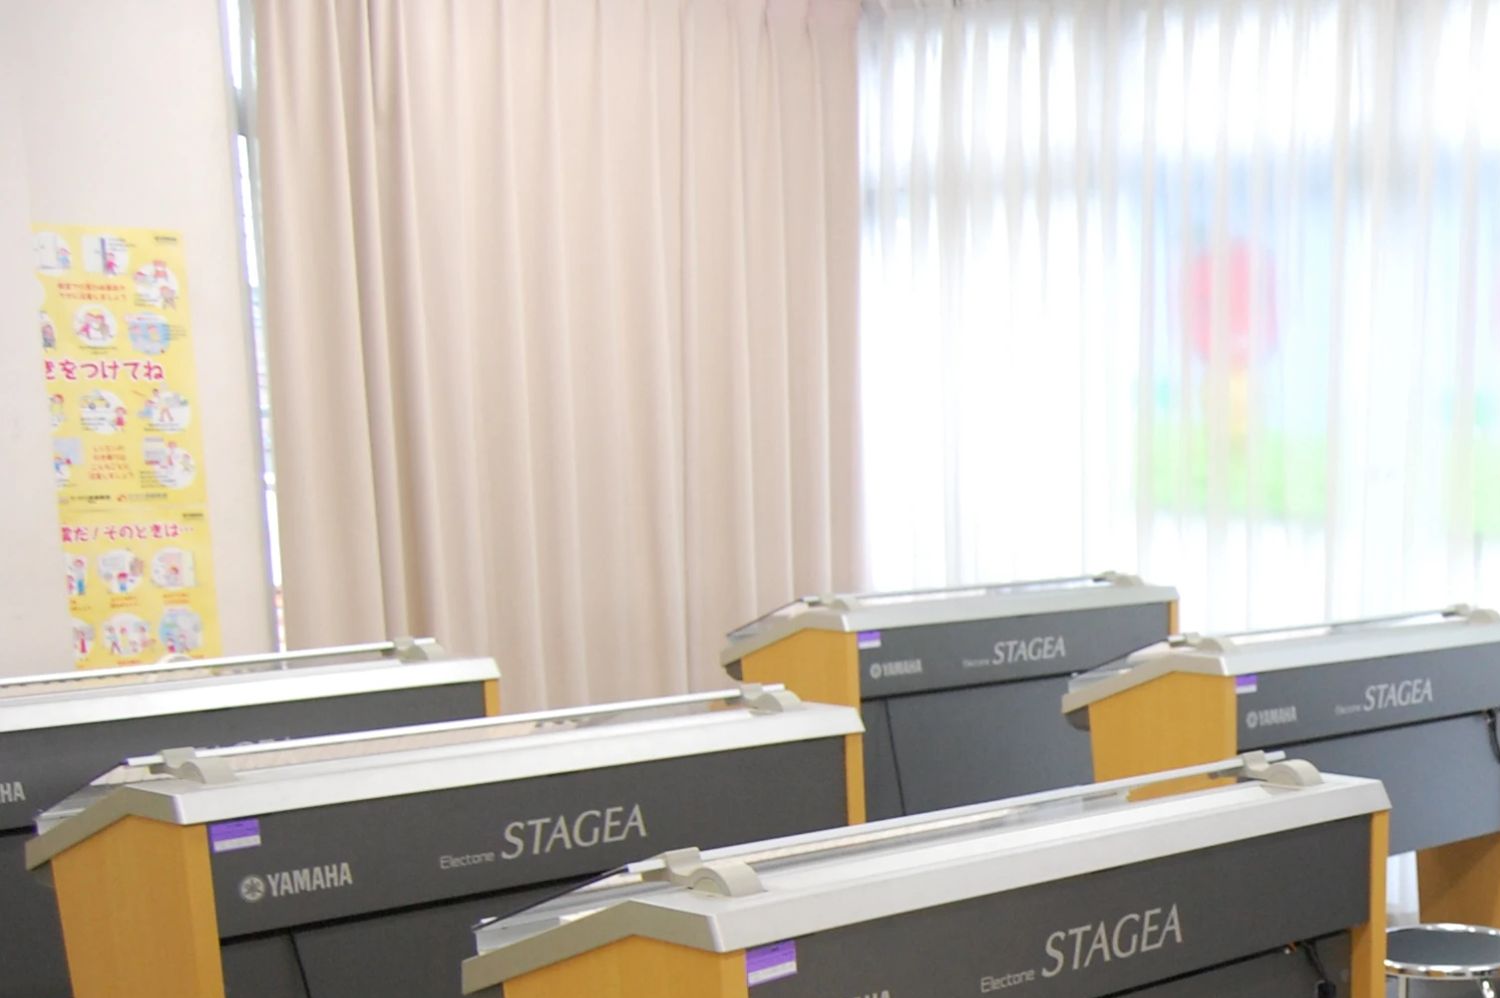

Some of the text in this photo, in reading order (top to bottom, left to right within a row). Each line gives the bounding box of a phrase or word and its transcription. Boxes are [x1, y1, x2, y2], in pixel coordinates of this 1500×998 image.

[992, 635, 1066, 665] STAGEA
[1362, 678, 1433, 712] STAGEA
[439, 803, 647, 870] Electone STAGEA
[266, 862, 353, 897] YAMAHA
[980, 903, 1183, 993] Electone STAGEA
